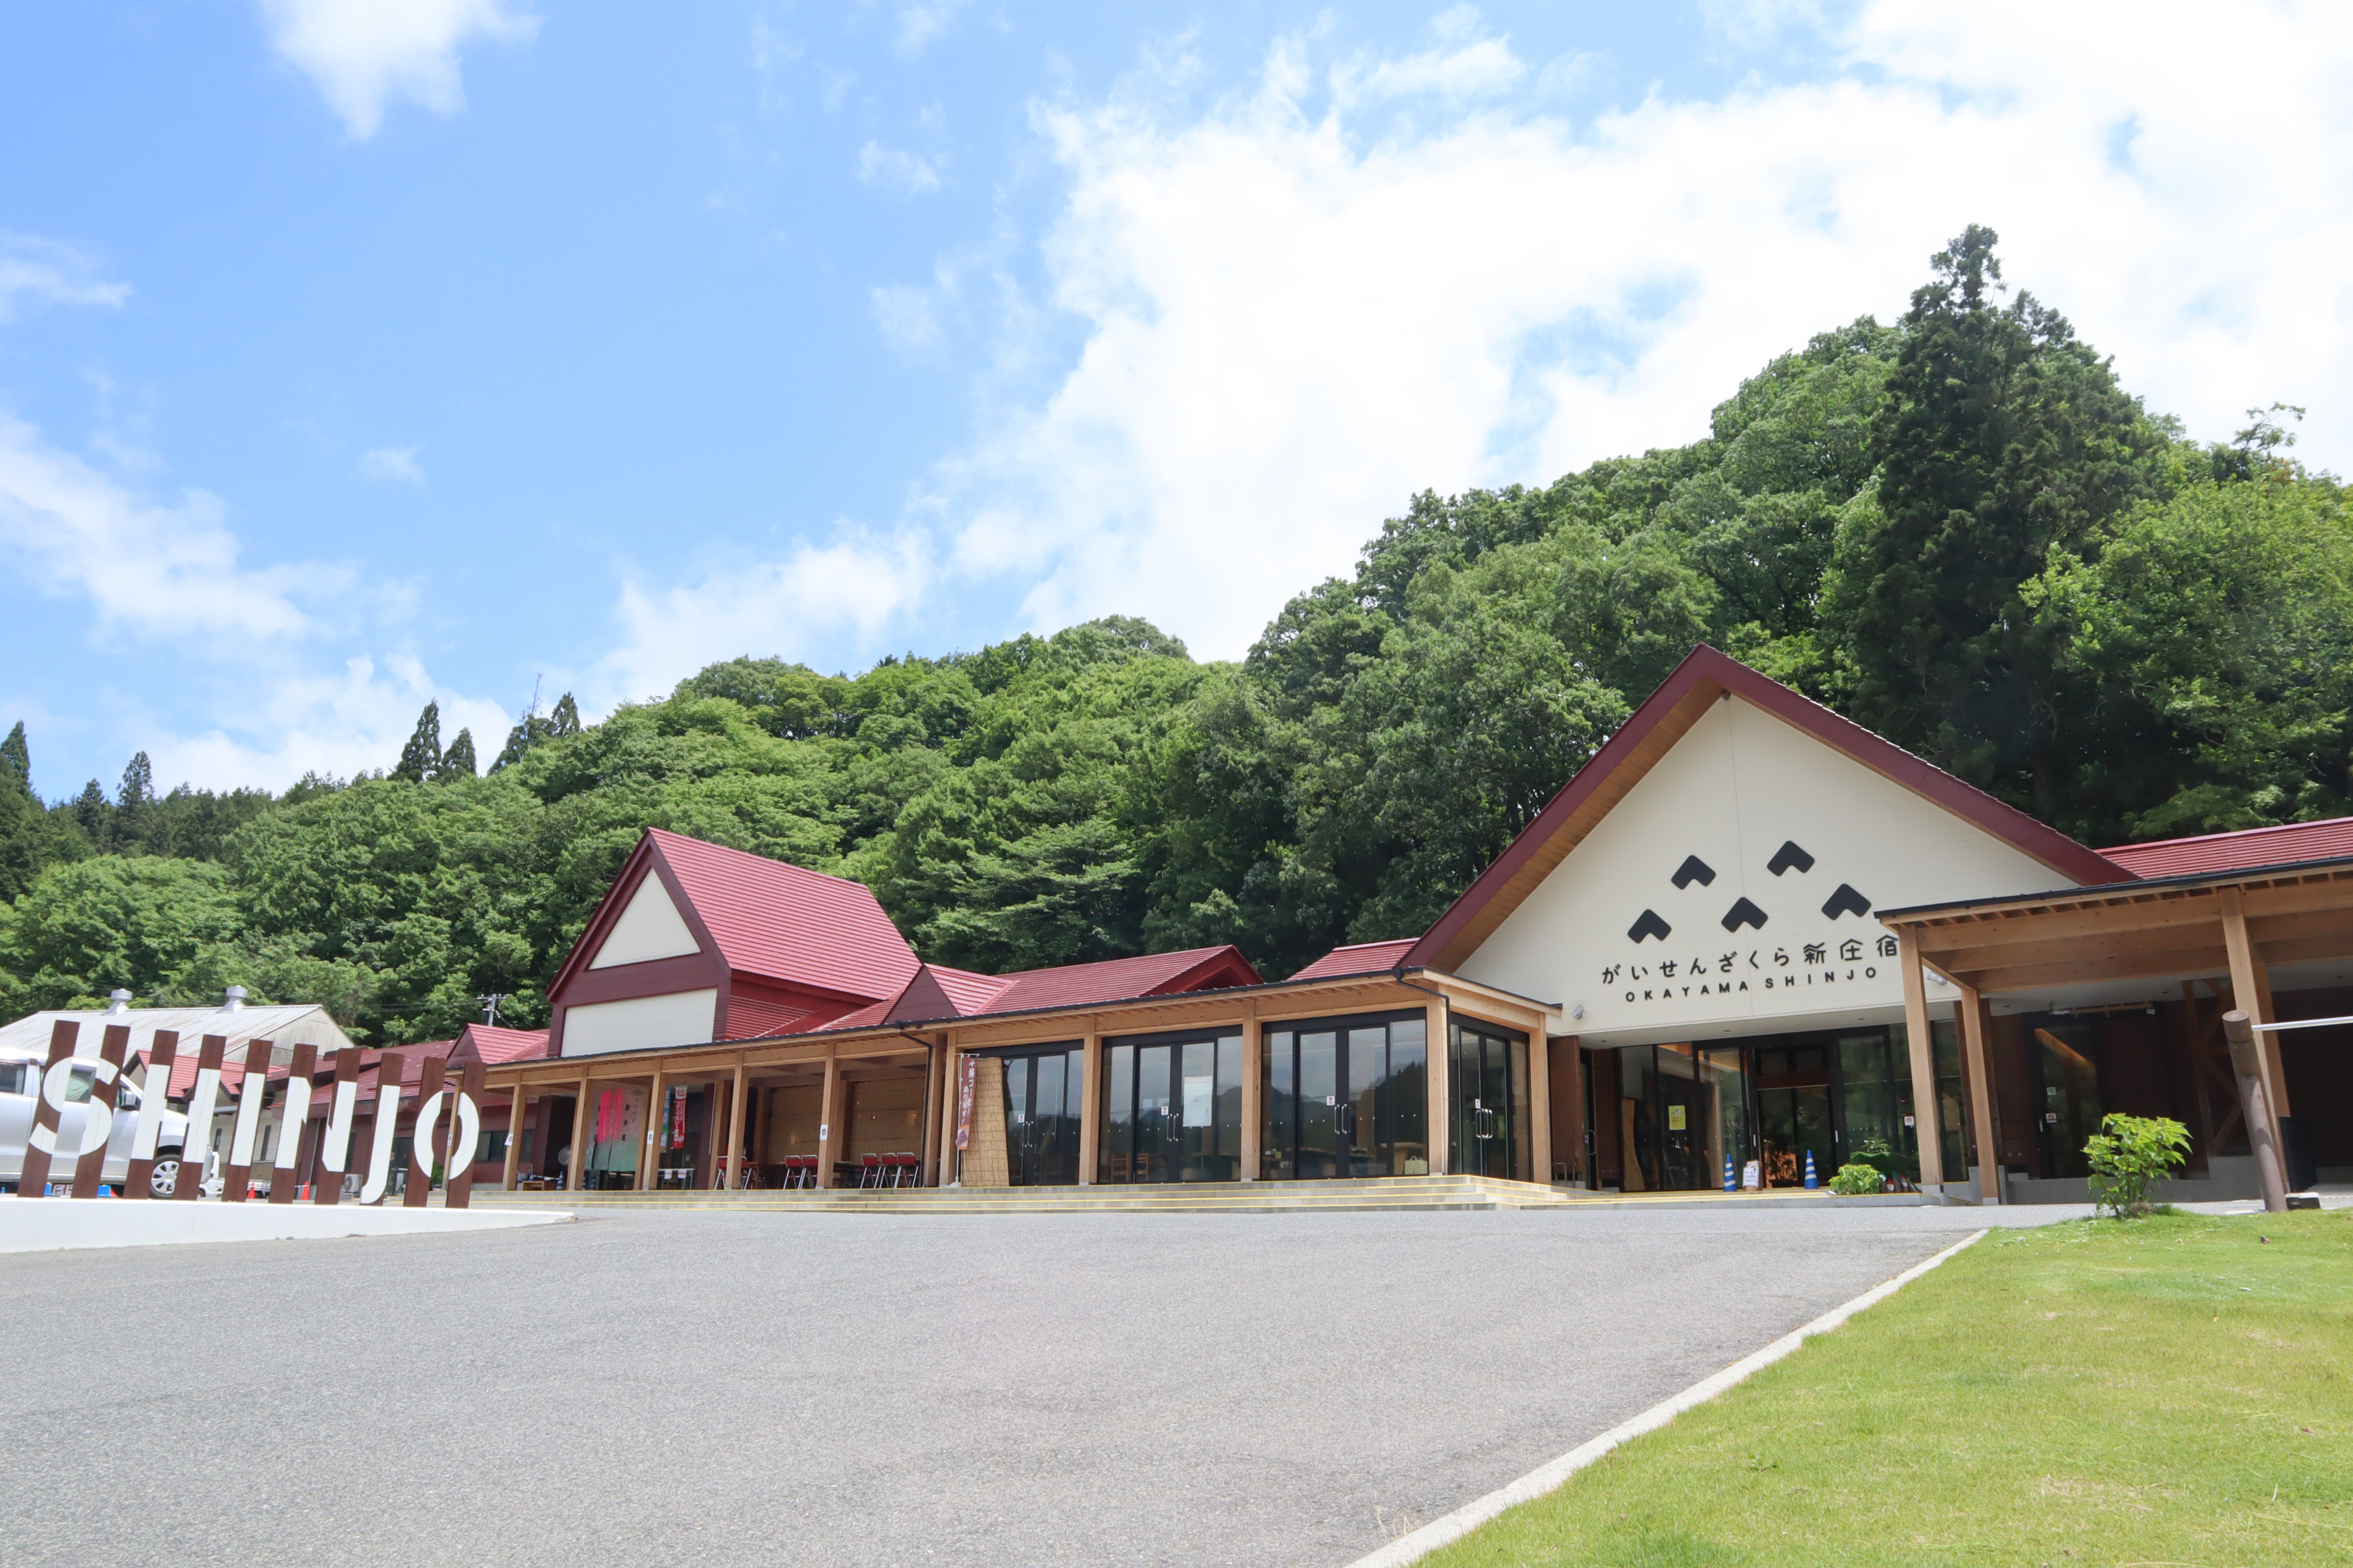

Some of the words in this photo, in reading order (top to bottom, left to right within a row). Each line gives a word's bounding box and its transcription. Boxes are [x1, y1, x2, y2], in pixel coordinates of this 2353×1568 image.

[1602, 934, 1899, 984] がいせんざくら新庄宿
[1625, 981, 1749, 1003] OKAYAMA
[1765, 967, 1877, 989] SHINJO
[28, 1056, 480, 1204] SHINJO
